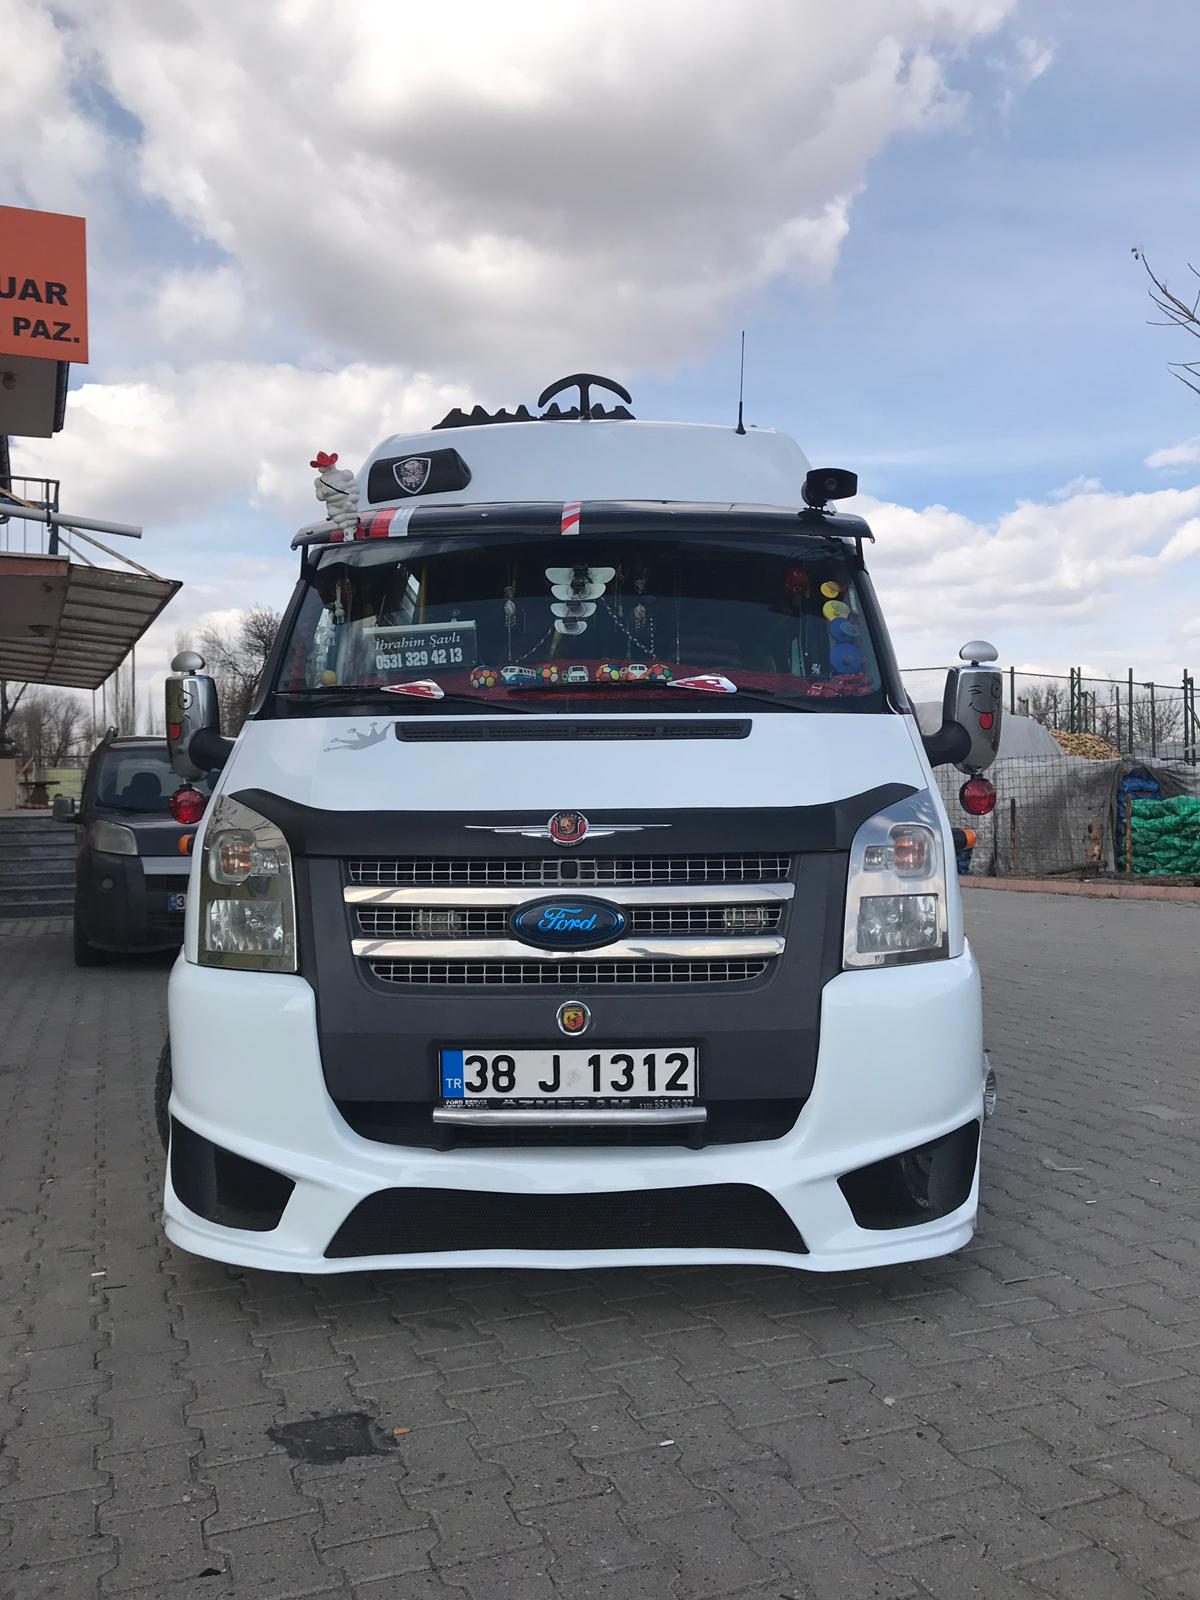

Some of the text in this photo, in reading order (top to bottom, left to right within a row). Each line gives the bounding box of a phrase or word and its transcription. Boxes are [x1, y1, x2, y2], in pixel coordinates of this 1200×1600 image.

[13, 316, 80, 343] PAZ.
[375, 647, 463, 670] 0531 329 42 13
[538, 907, 598, 931] Ford
[445, 1053, 689, 1093] TR 38 J 1312
